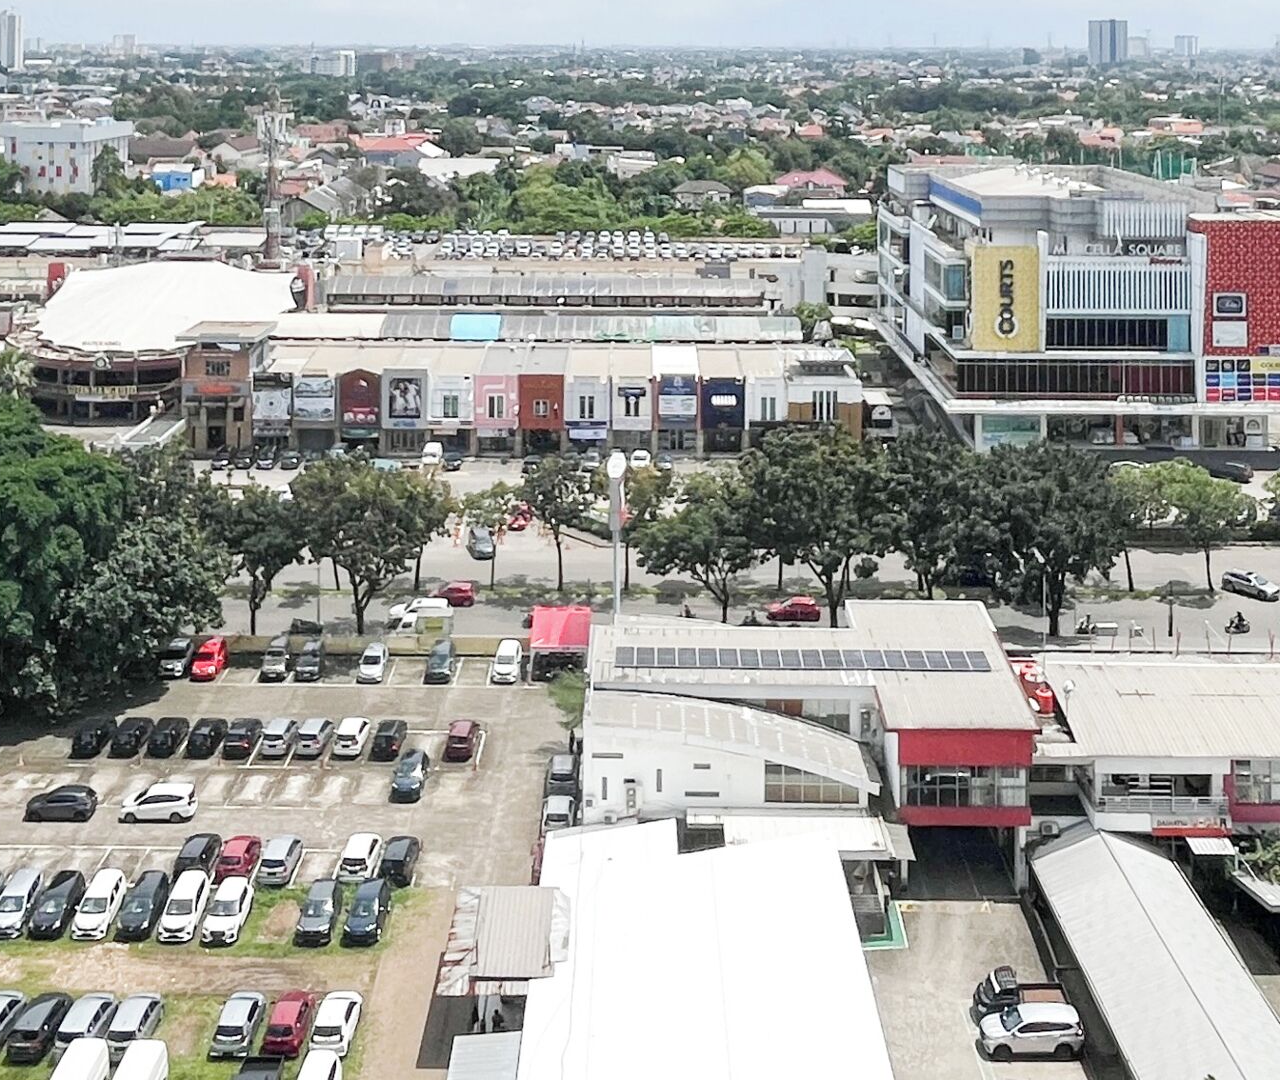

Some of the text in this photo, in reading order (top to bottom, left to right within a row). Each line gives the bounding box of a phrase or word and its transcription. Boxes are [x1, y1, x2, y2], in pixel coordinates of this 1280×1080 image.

[1053, 243, 1180, 256] MCELLA SQUARE
[997, 259, 1016, 336] COURTS
